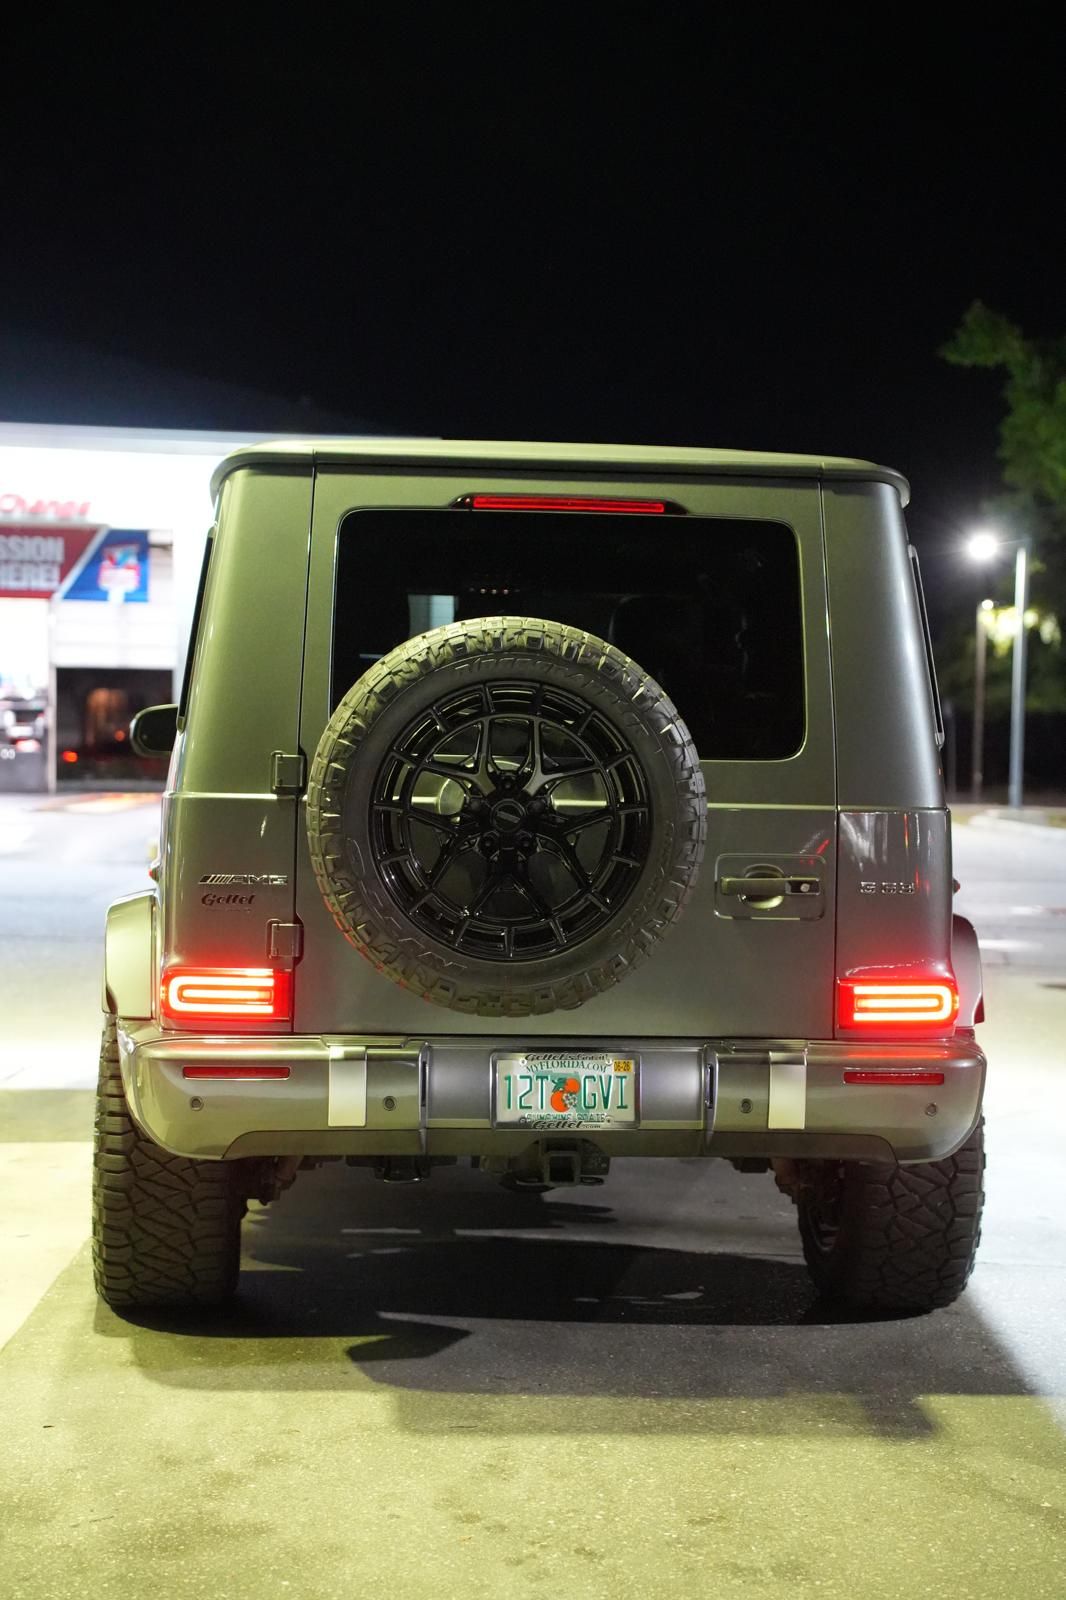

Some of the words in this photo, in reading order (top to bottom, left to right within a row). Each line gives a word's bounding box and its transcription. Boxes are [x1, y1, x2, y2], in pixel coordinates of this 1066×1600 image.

[526, 1060, 607, 1073] MYFLORIDA.COM
[504, 1075, 550, 1110] 12T
[583, 1075, 629, 1110] GVI
